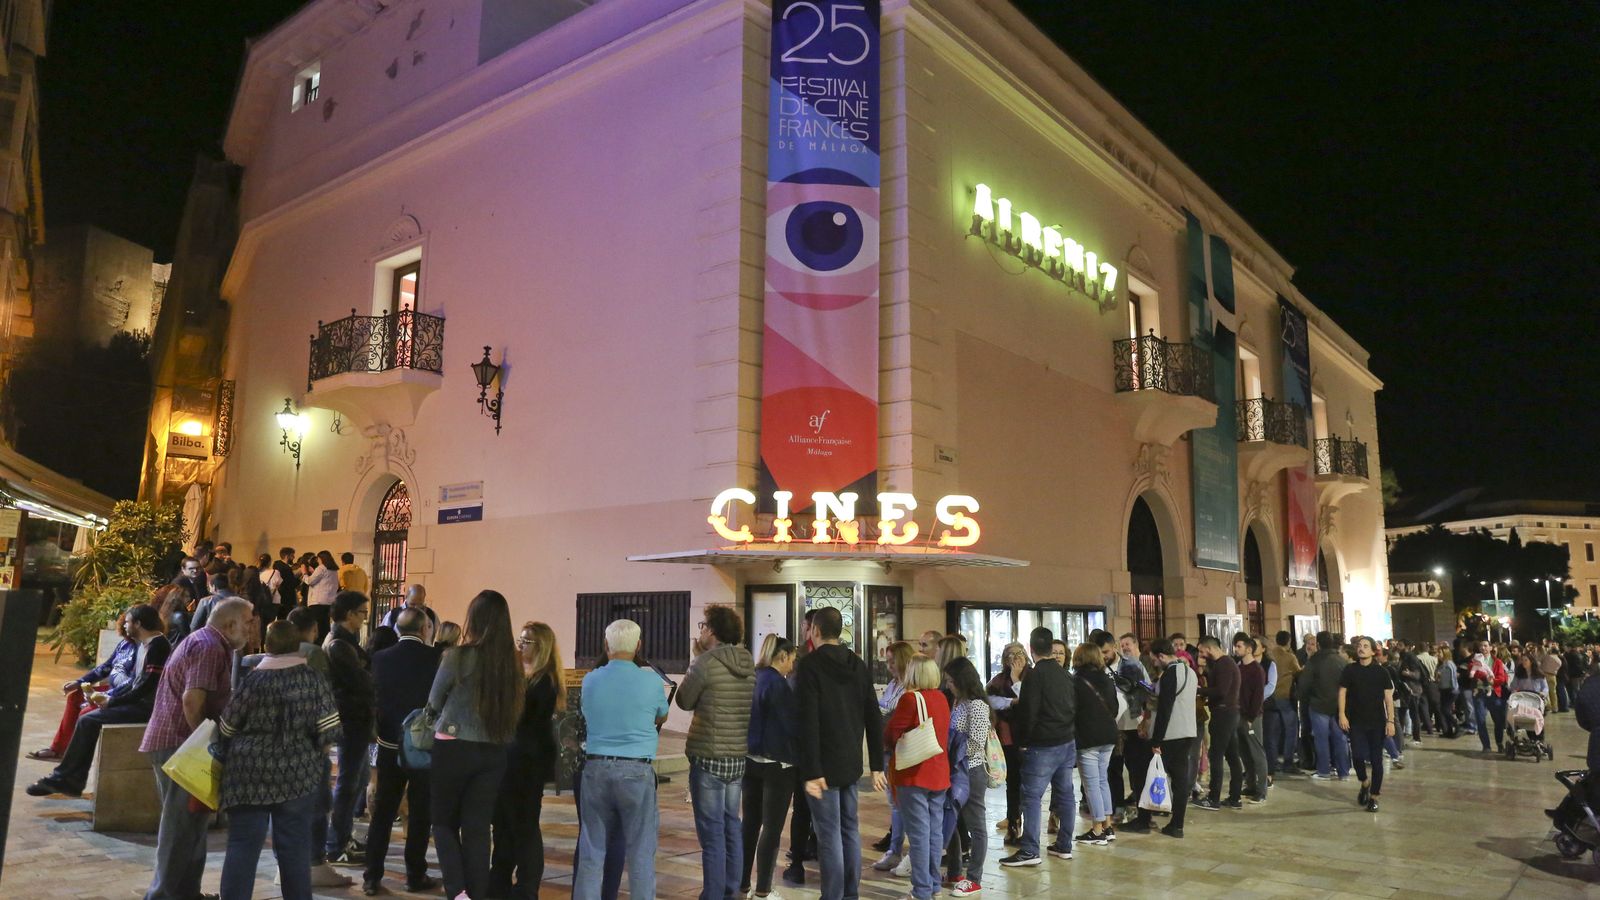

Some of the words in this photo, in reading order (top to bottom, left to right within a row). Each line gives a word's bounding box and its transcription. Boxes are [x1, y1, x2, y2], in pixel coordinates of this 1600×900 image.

[781, 1, 870, 65] 25
[780, 76, 869, 99] FESTIVAL
[780, 97, 808, 116] DE
[814, 99, 869, 119] CINE
[779, 118, 870, 141] FRANCÉS
[779, 141, 794, 150] DE
[1280, 305, 1297, 348] 25
[809, 409, 831, 434] af
[172, 435, 205, 449] Bilba.
[707, 488, 981, 546] CINES
